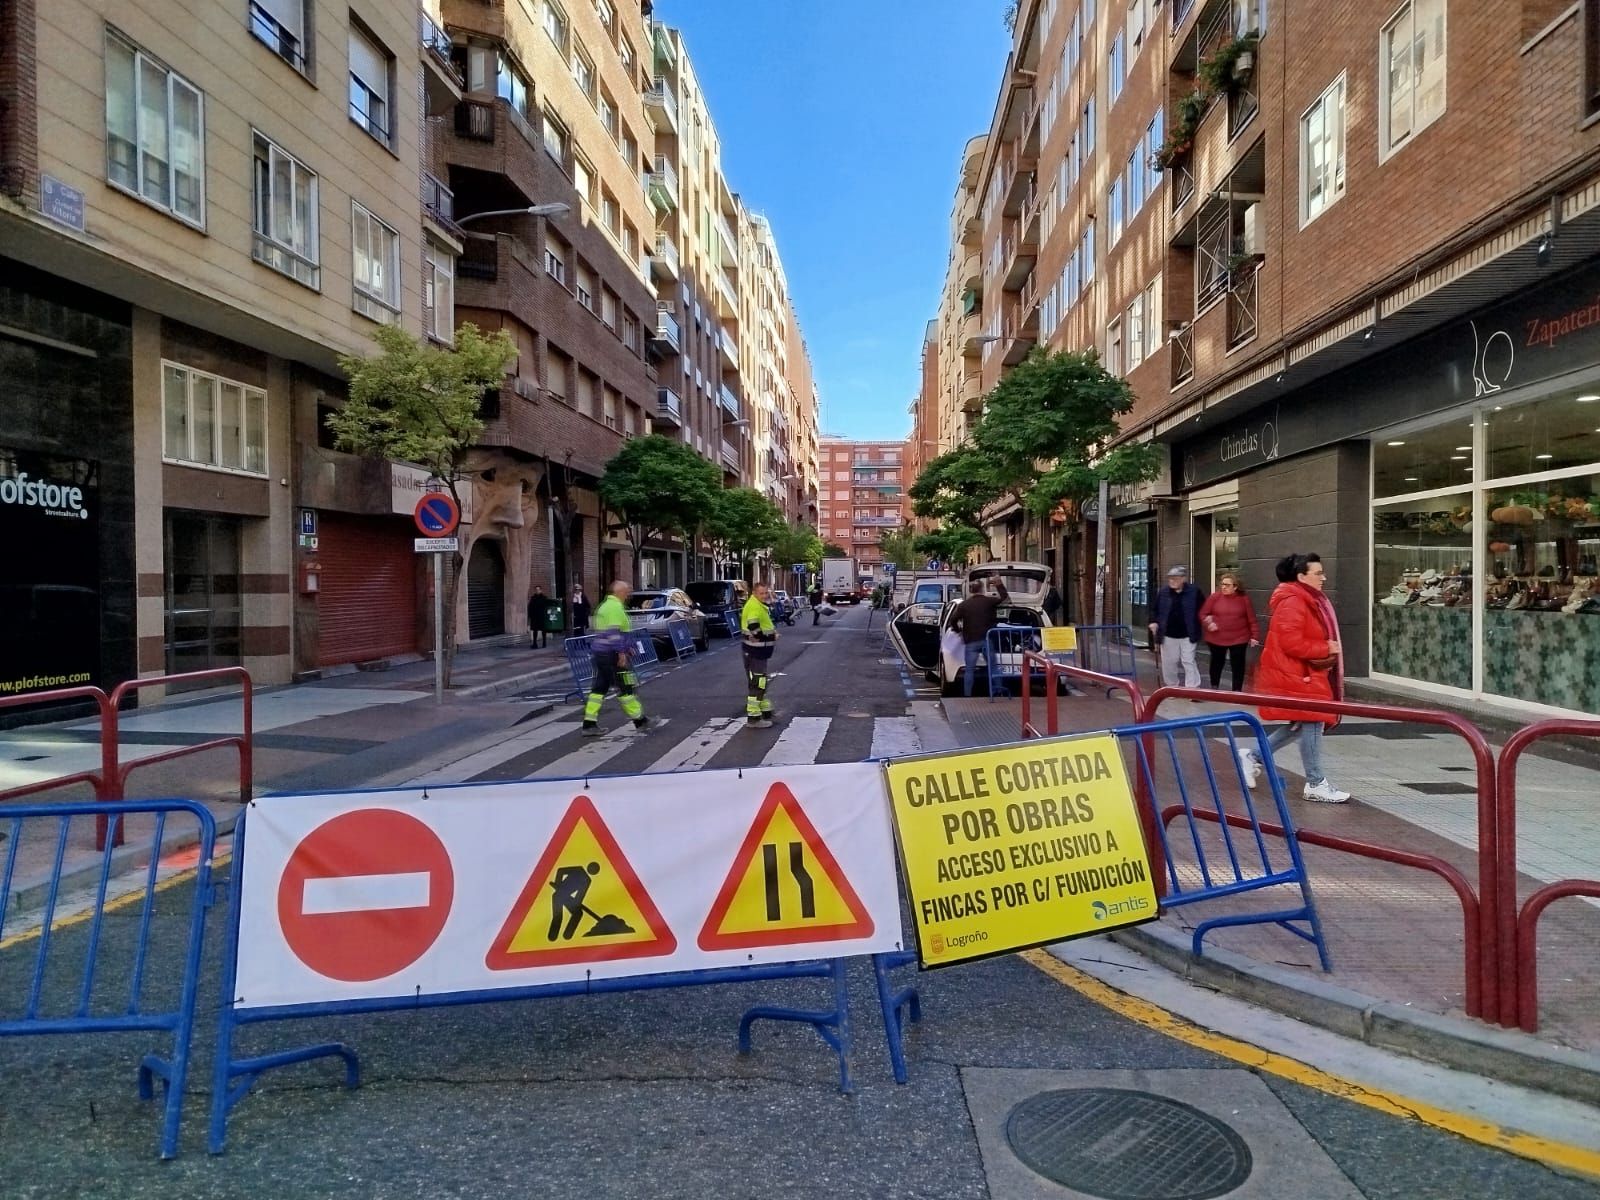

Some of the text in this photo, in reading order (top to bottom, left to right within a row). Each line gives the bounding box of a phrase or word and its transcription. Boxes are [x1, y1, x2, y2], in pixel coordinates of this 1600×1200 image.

[1220, 428, 1258, 462] Chinelas
[906, 751, 1112, 808] CALLE CORTADA
[942, 793, 1094, 845] POR OBRAS
[937, 830, 1119, 883] ACCESO EXCLUSIVO A
[921, 856, 1146, 925] FINCAS POR C/ FUNDICIÓN
[1108, 895, 1149, 915] antis
[946, 930, 989, 948] Logroño
